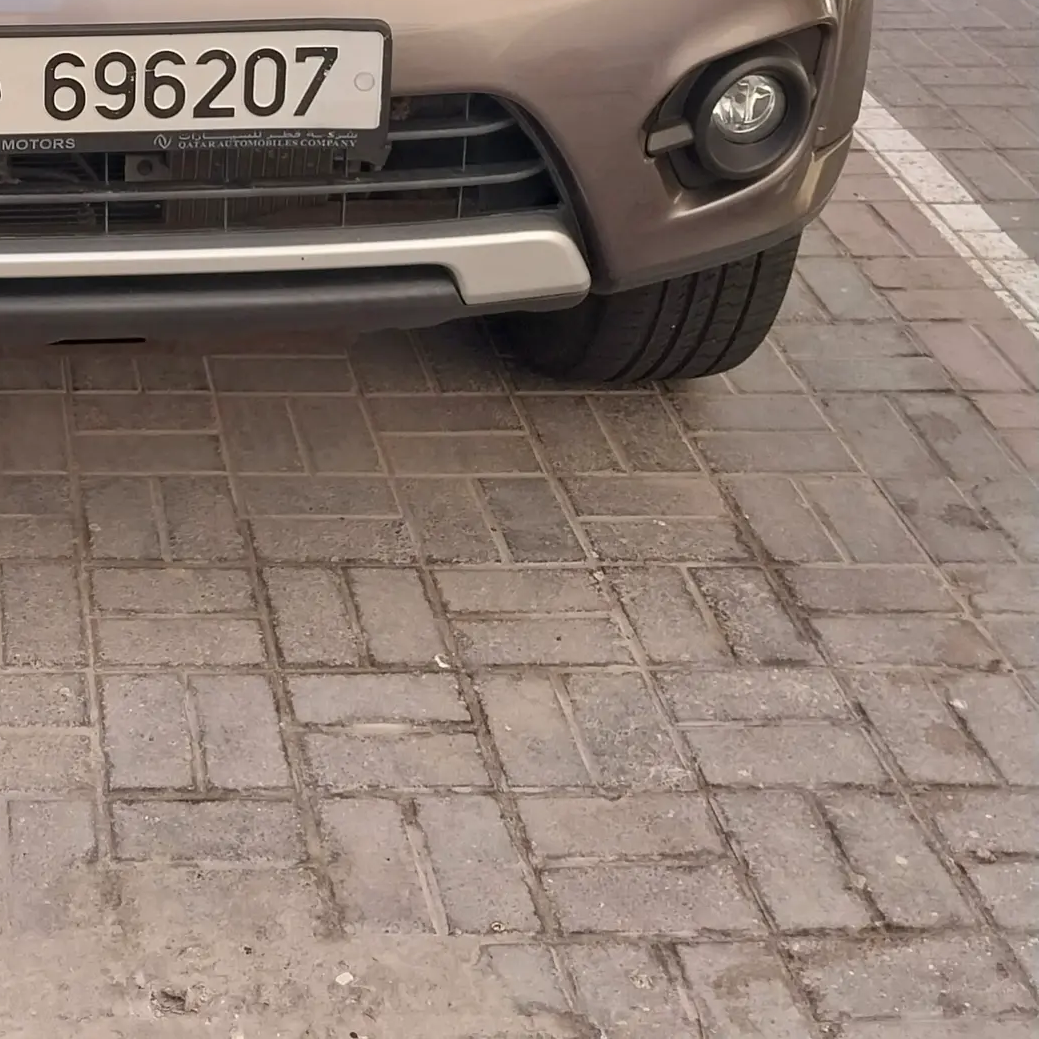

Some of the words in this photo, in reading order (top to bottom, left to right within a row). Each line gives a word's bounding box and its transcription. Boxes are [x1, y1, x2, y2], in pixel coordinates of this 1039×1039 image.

[42, 46, 340, 121] 696207
[2, 138, 76, 151] MOTORS
[178, 140, 216, 149] QATAR
[218, 139, 299, 148] AUTOMOBILES
[300, 139, 356, 147] COMPANY
